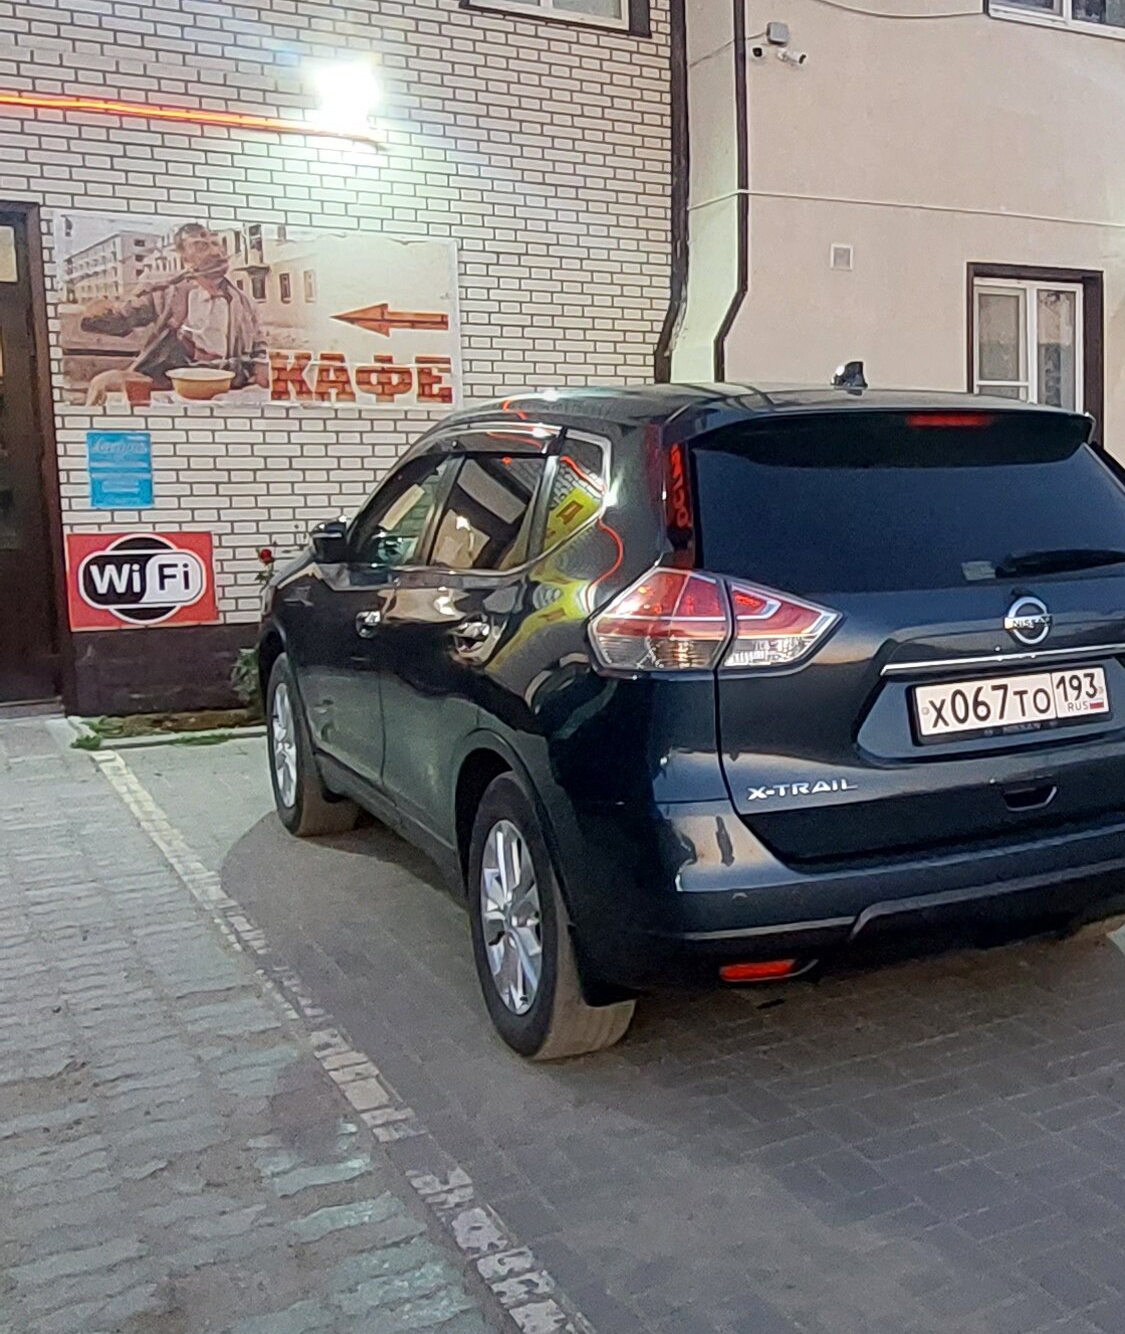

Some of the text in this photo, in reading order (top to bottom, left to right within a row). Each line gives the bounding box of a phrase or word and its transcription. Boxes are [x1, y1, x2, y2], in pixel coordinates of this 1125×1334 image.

[269, 352, 453, 403] КАФЕ
[1056, 672, 1098, 702] 193
[1067, 700, 1089, 712] RUS
[747, 778, 858, 801] X-TRAIL
